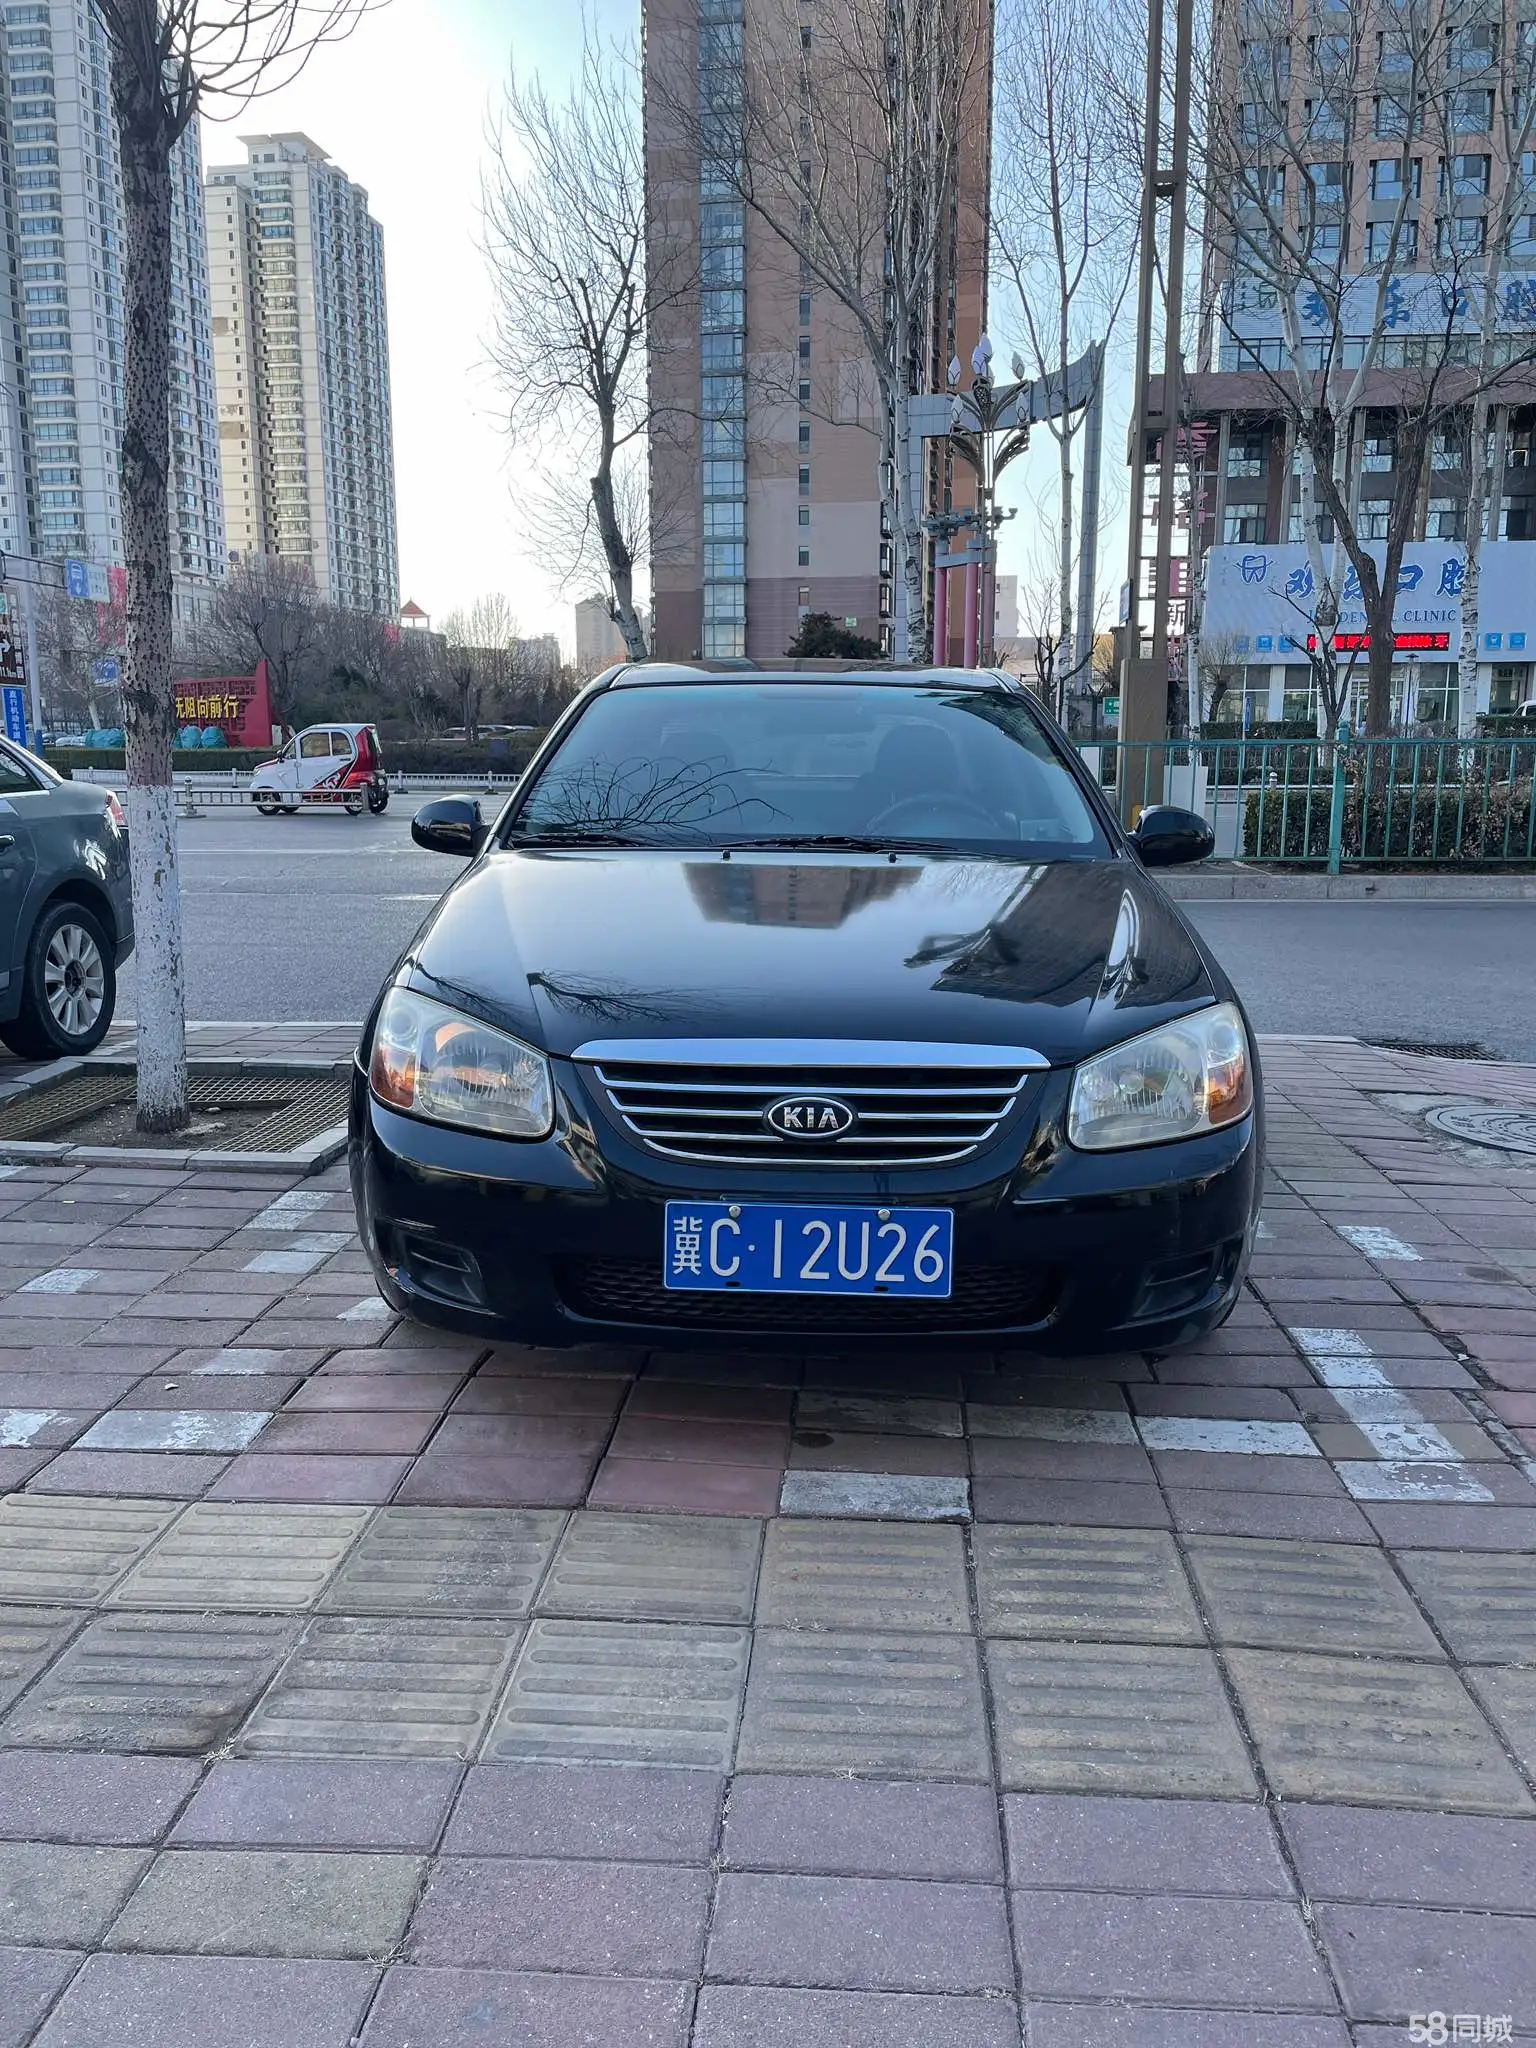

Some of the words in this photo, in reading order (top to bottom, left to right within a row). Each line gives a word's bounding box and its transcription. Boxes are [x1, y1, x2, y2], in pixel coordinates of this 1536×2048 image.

[1403, 610, 1456, 622] CLINIC
[175, 694, 239, 718] 无阻向前行
[783, 1107, 839, 1128] KIA
